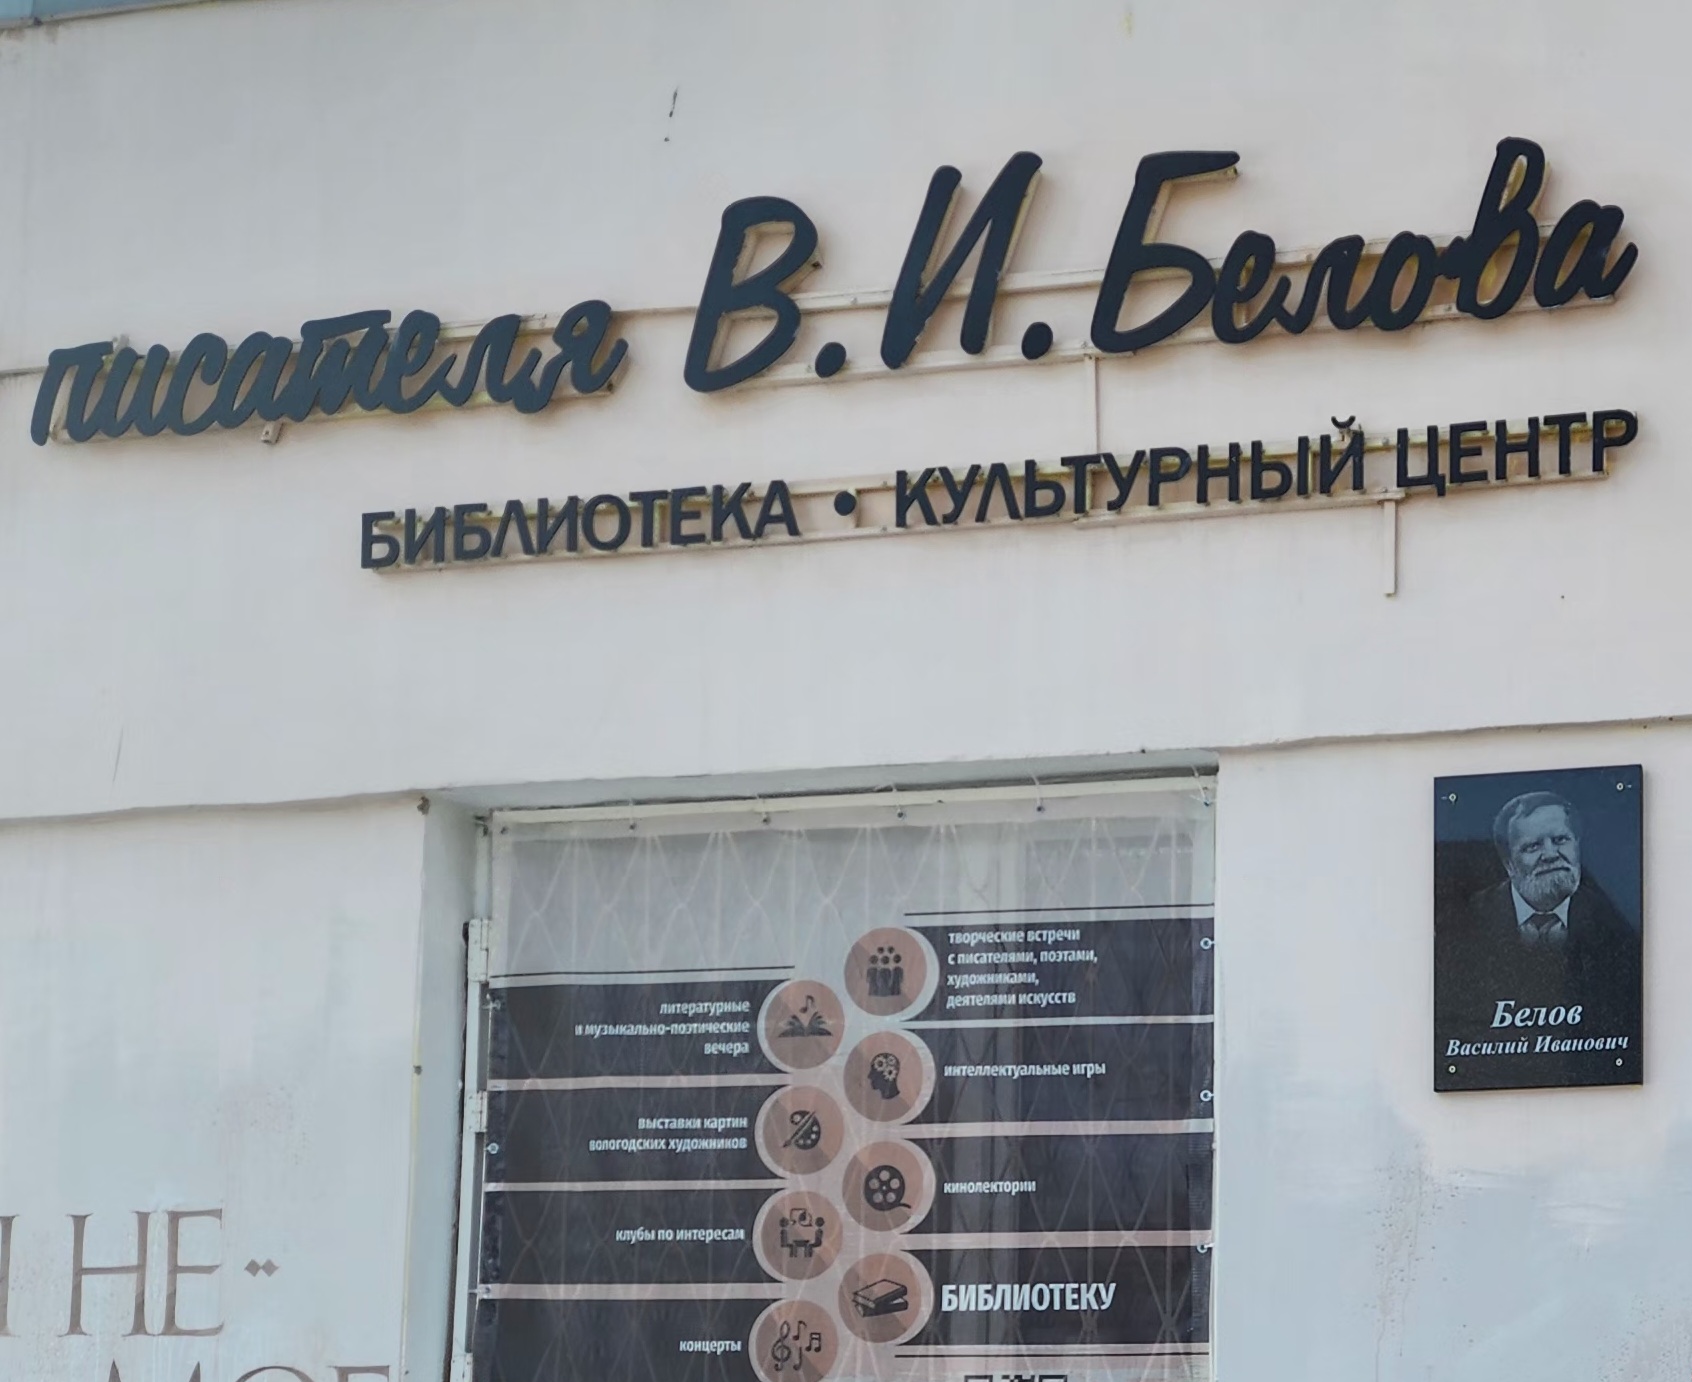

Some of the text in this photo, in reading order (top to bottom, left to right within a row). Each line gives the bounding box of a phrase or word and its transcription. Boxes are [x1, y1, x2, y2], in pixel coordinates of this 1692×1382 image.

[31, 299, 628, 445] писателя
[361, 409, 1639, 569] БИБЛИОТЕКА КУЛЬТУРНЫЙ ЦЕНТР
[948, 929, 1080, 947] творческие встречи
[948, 949, 1098, 965] с писателями, поэтами,
[947, 972, 1040, 989] художниками,
[660, 1000, 750, 1017] литературные
[946, 992, 1076, 1009] деятелями искусств
[1490, 1000, 1583, 1028] Белов
[575, 1021, 750, 1038] и музыкально-поэтические
[704, 1042, 750, 1057] вечера
[1446, 1034, 1628, 1057] Василий Иванович
[944, 1062, 1106, 1079] интеллектуальные игры
[638, 1116, 748, 1132] выставки картин
[589, 1137, 748, 1153] вологодских художников
[943, 1179, 1036, 1197] кинолектории
[615, 1227, 745, 1245] клубы по интересам
[59, 1207, 226, 1338] НЕ
[941, 1282, 1117, 1312] БИБЛИОТЕКУ
[679, 1339, 742, 1355] концерты
